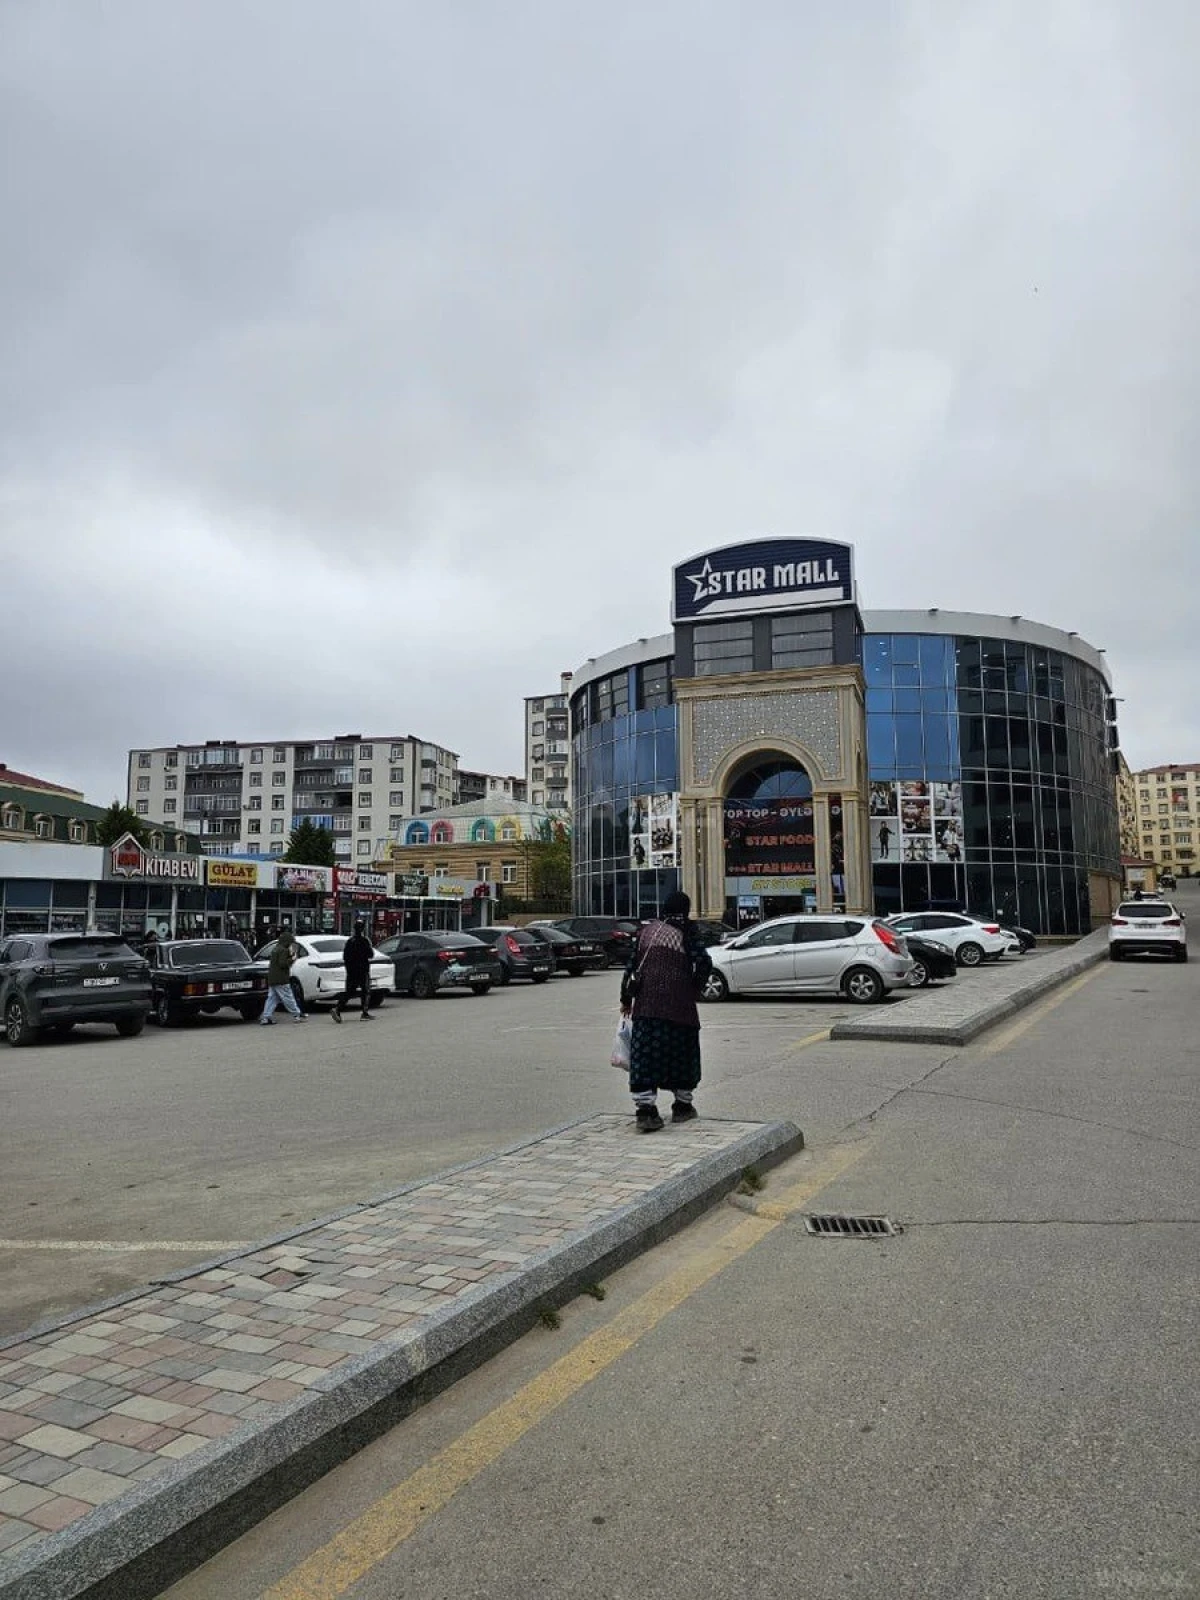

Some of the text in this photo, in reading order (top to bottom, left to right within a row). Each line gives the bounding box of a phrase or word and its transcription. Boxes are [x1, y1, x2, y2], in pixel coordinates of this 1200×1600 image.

[708, 558, 839, 593] STAR MALL
[747, 808, 768, 819] TOP
